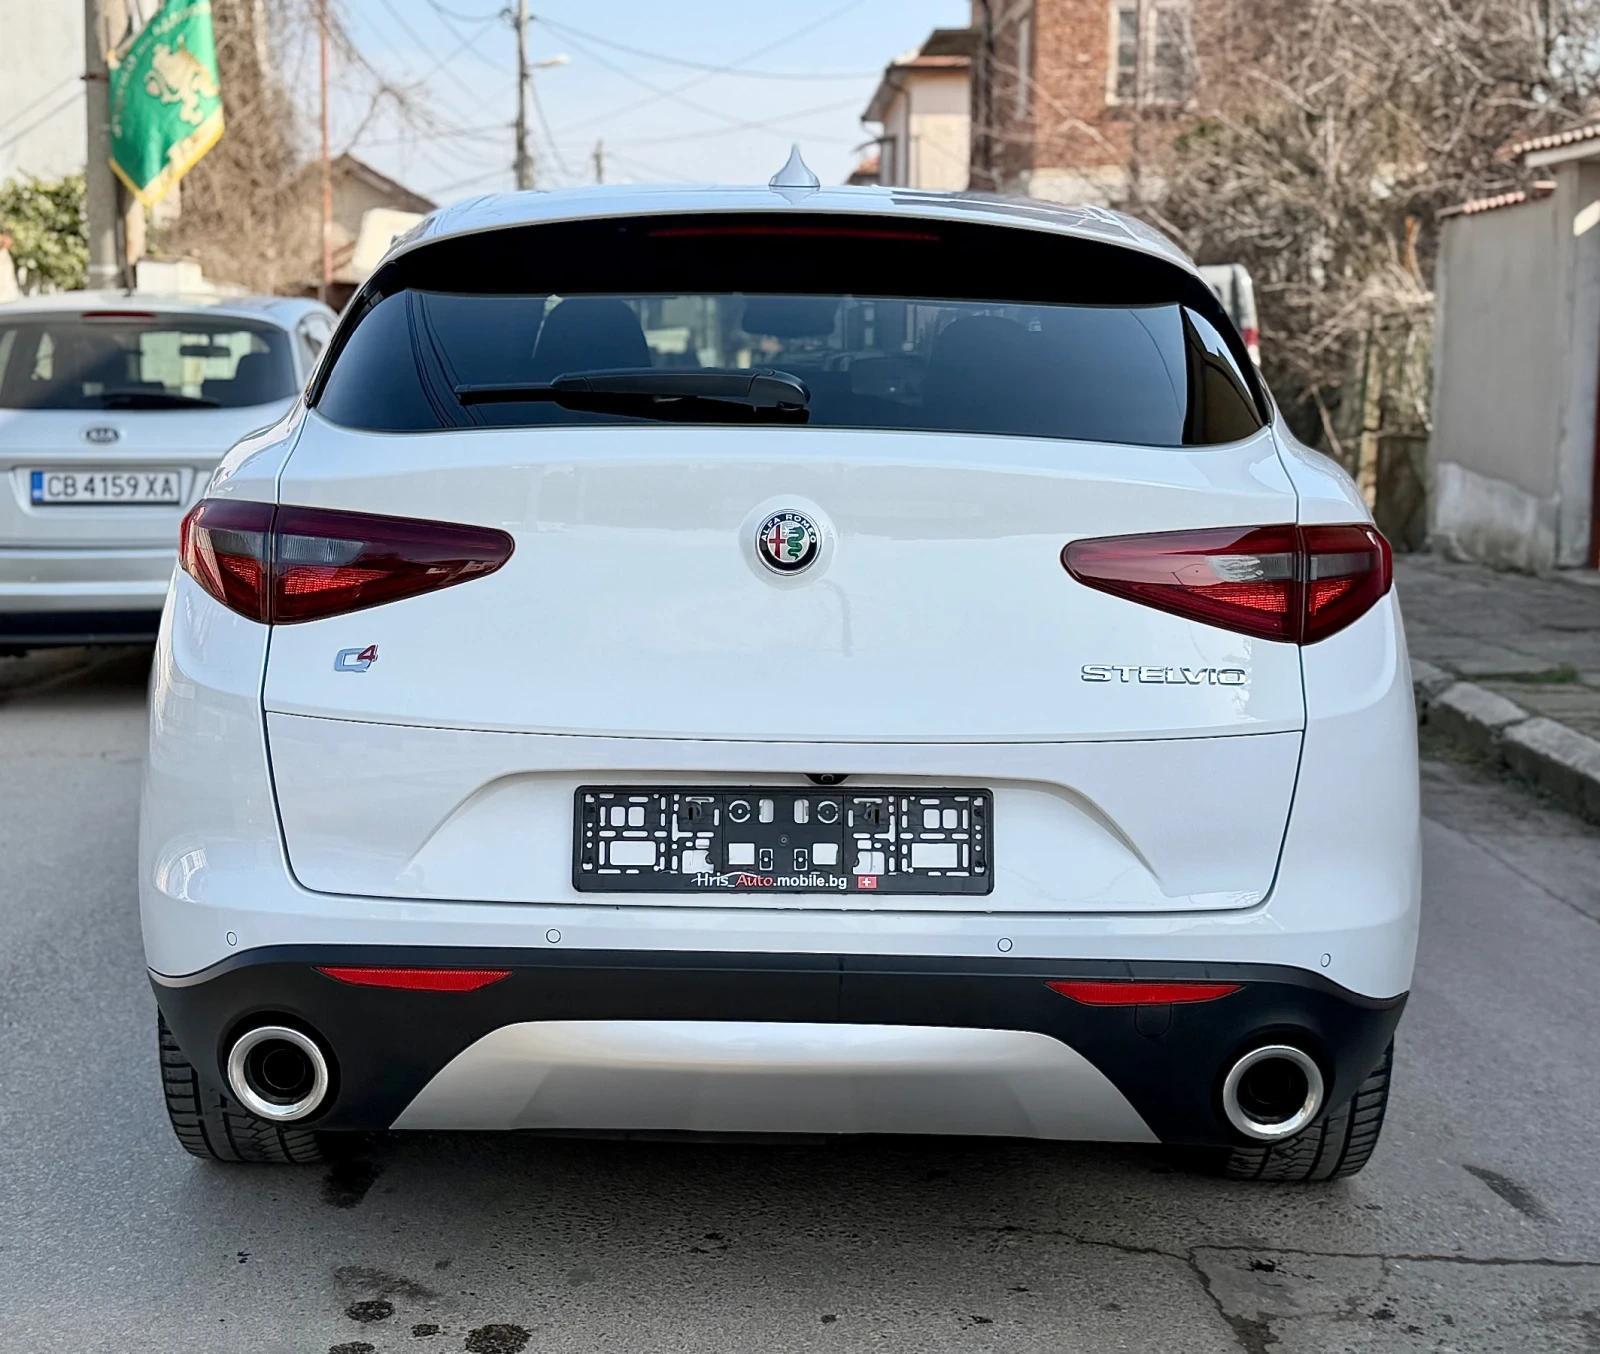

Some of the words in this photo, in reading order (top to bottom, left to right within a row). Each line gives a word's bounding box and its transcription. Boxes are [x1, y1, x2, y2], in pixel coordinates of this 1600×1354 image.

[84, 476, 139, 497] 4159
[761, 517, 780, 541] ALFA
[785, 514, 816, 543] ROMEO
[1081, 664, 1246, 686] STELVIO
